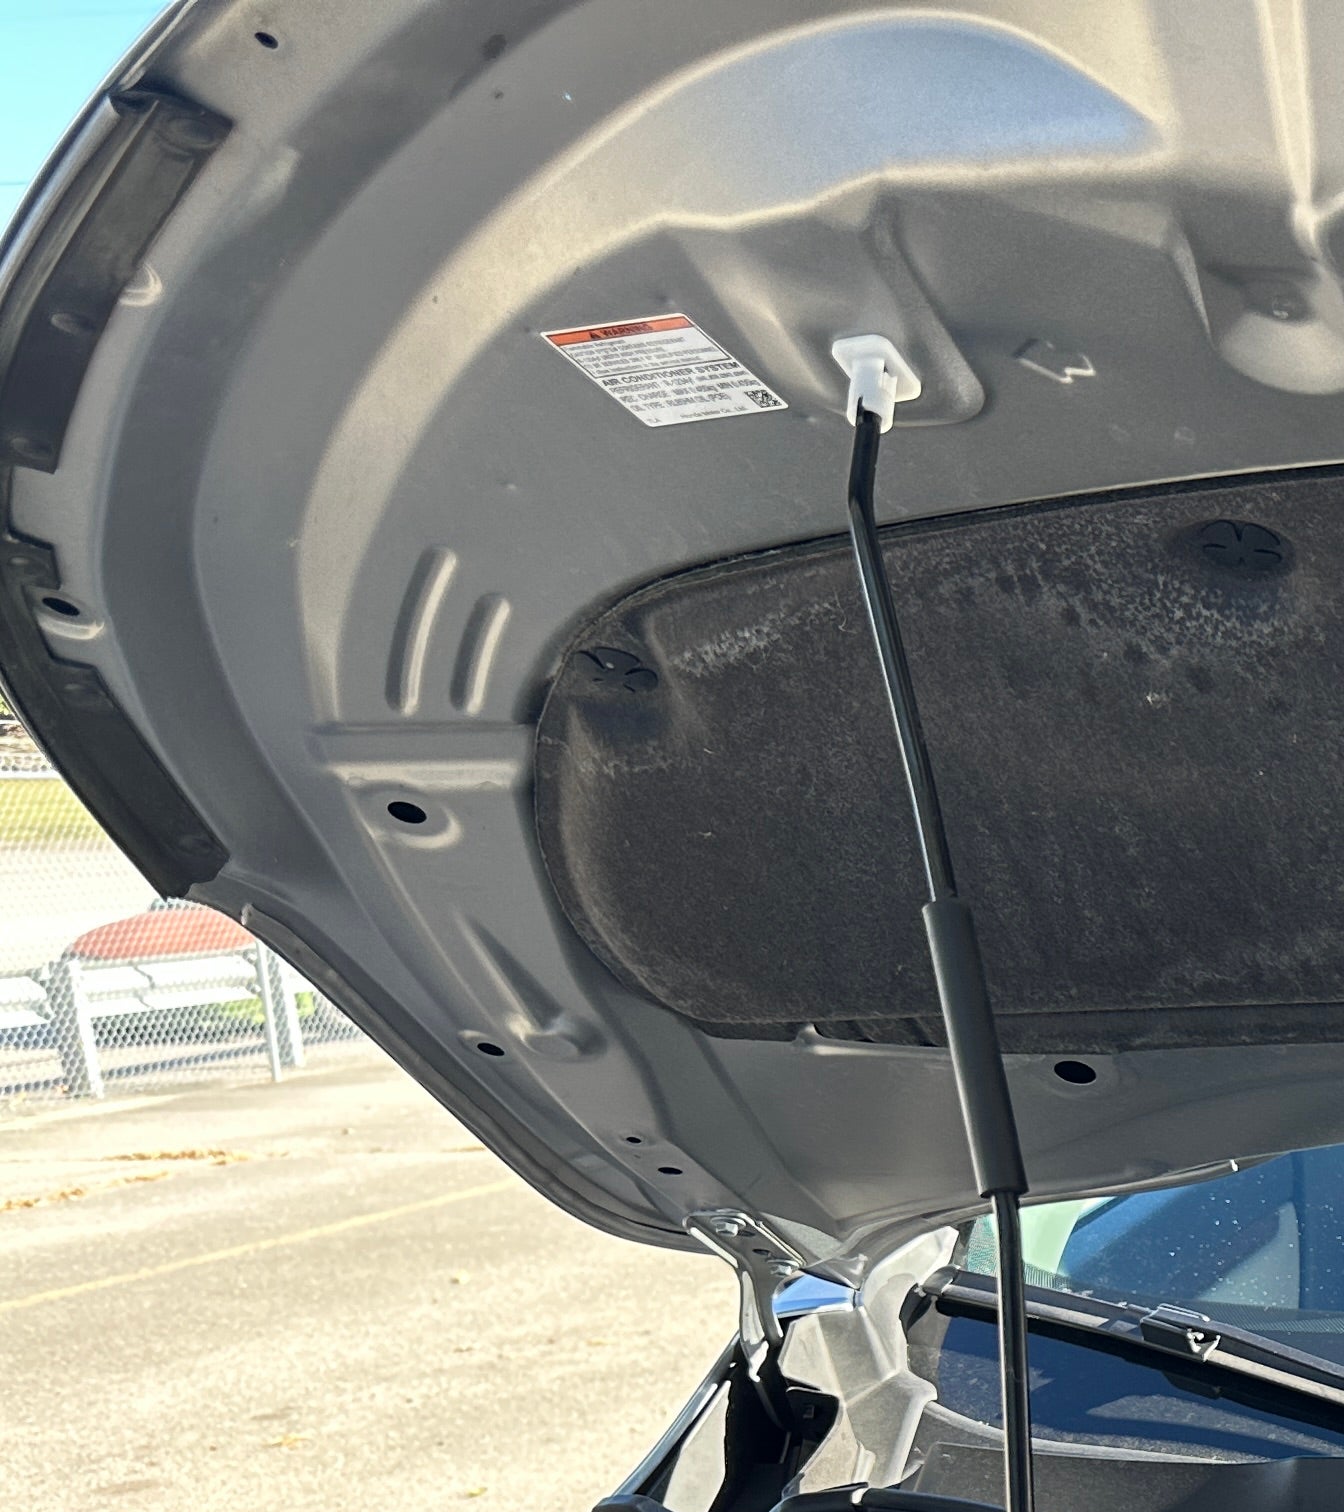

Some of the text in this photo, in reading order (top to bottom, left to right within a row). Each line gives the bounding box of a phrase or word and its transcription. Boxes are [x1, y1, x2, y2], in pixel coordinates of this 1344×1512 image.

[601, 322, 654, 338] WARNING
[601, 377, 621, 386] AIR
[620, 367, 694, 384] CONDITIONER
[694, 360, 740, 373] SYSTEM
